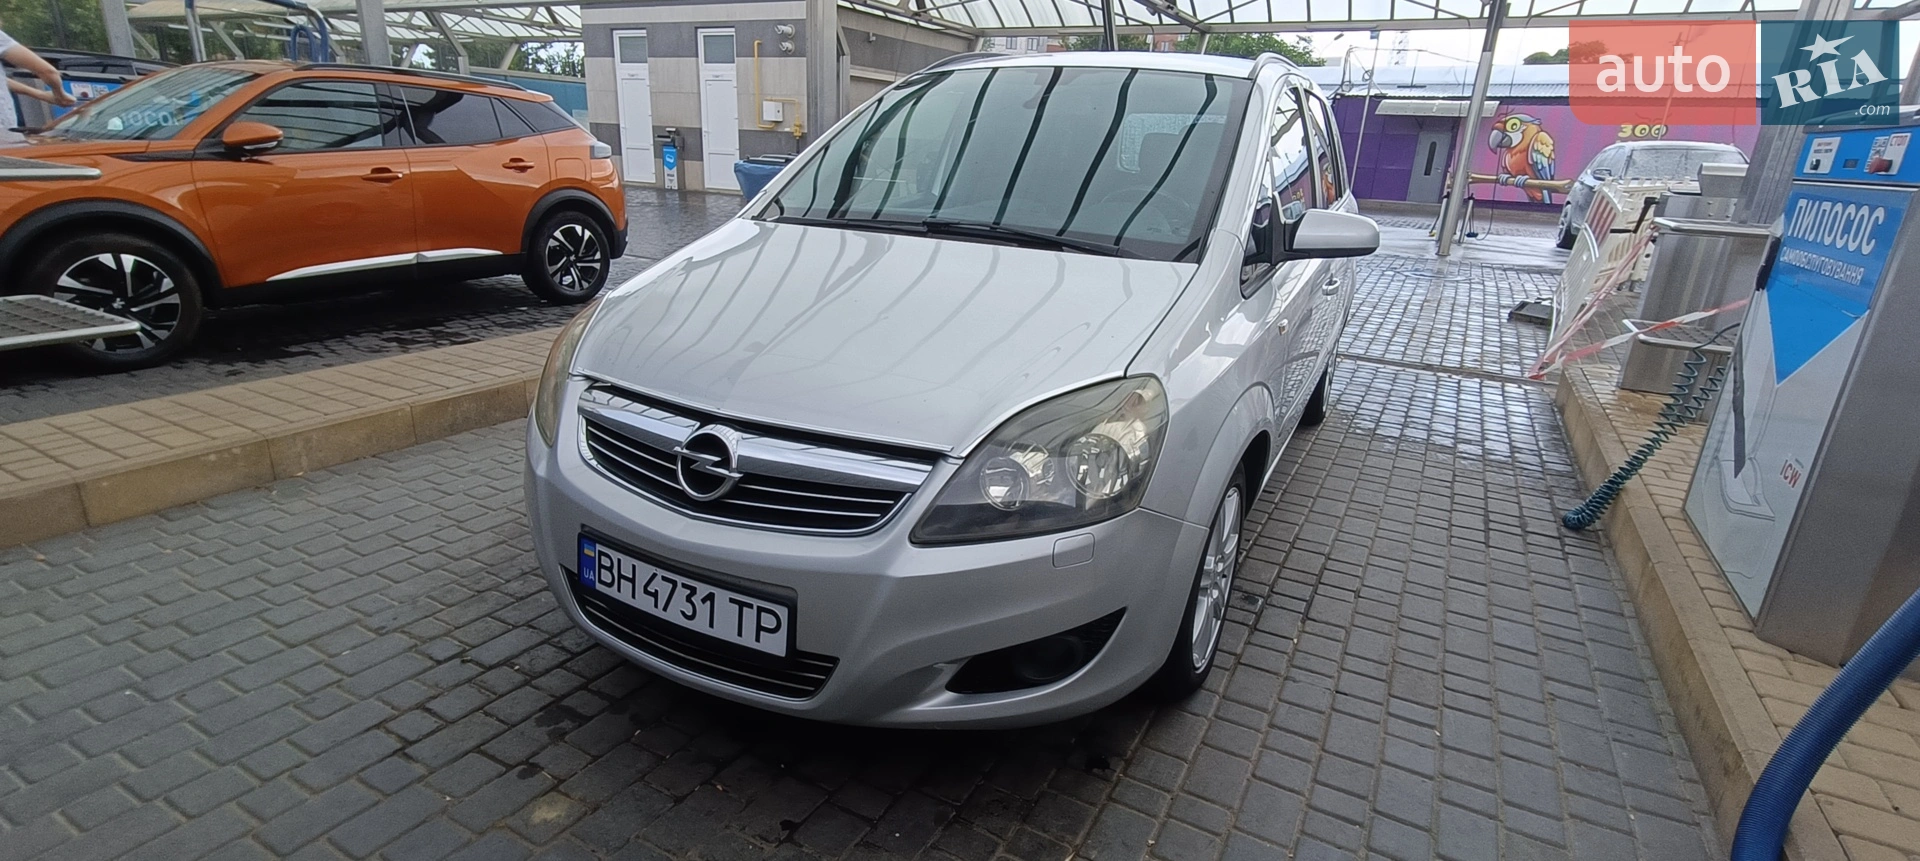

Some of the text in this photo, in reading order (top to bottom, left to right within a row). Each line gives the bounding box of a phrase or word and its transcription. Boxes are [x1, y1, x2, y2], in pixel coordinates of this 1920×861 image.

[1787, 198, 1885, 256] ПИЛОСОС
[1779, 459, 1802, 489] ICW
[583, 566, 595, 582] UA
[597, 549, 783, 644] BH 4731 TP
